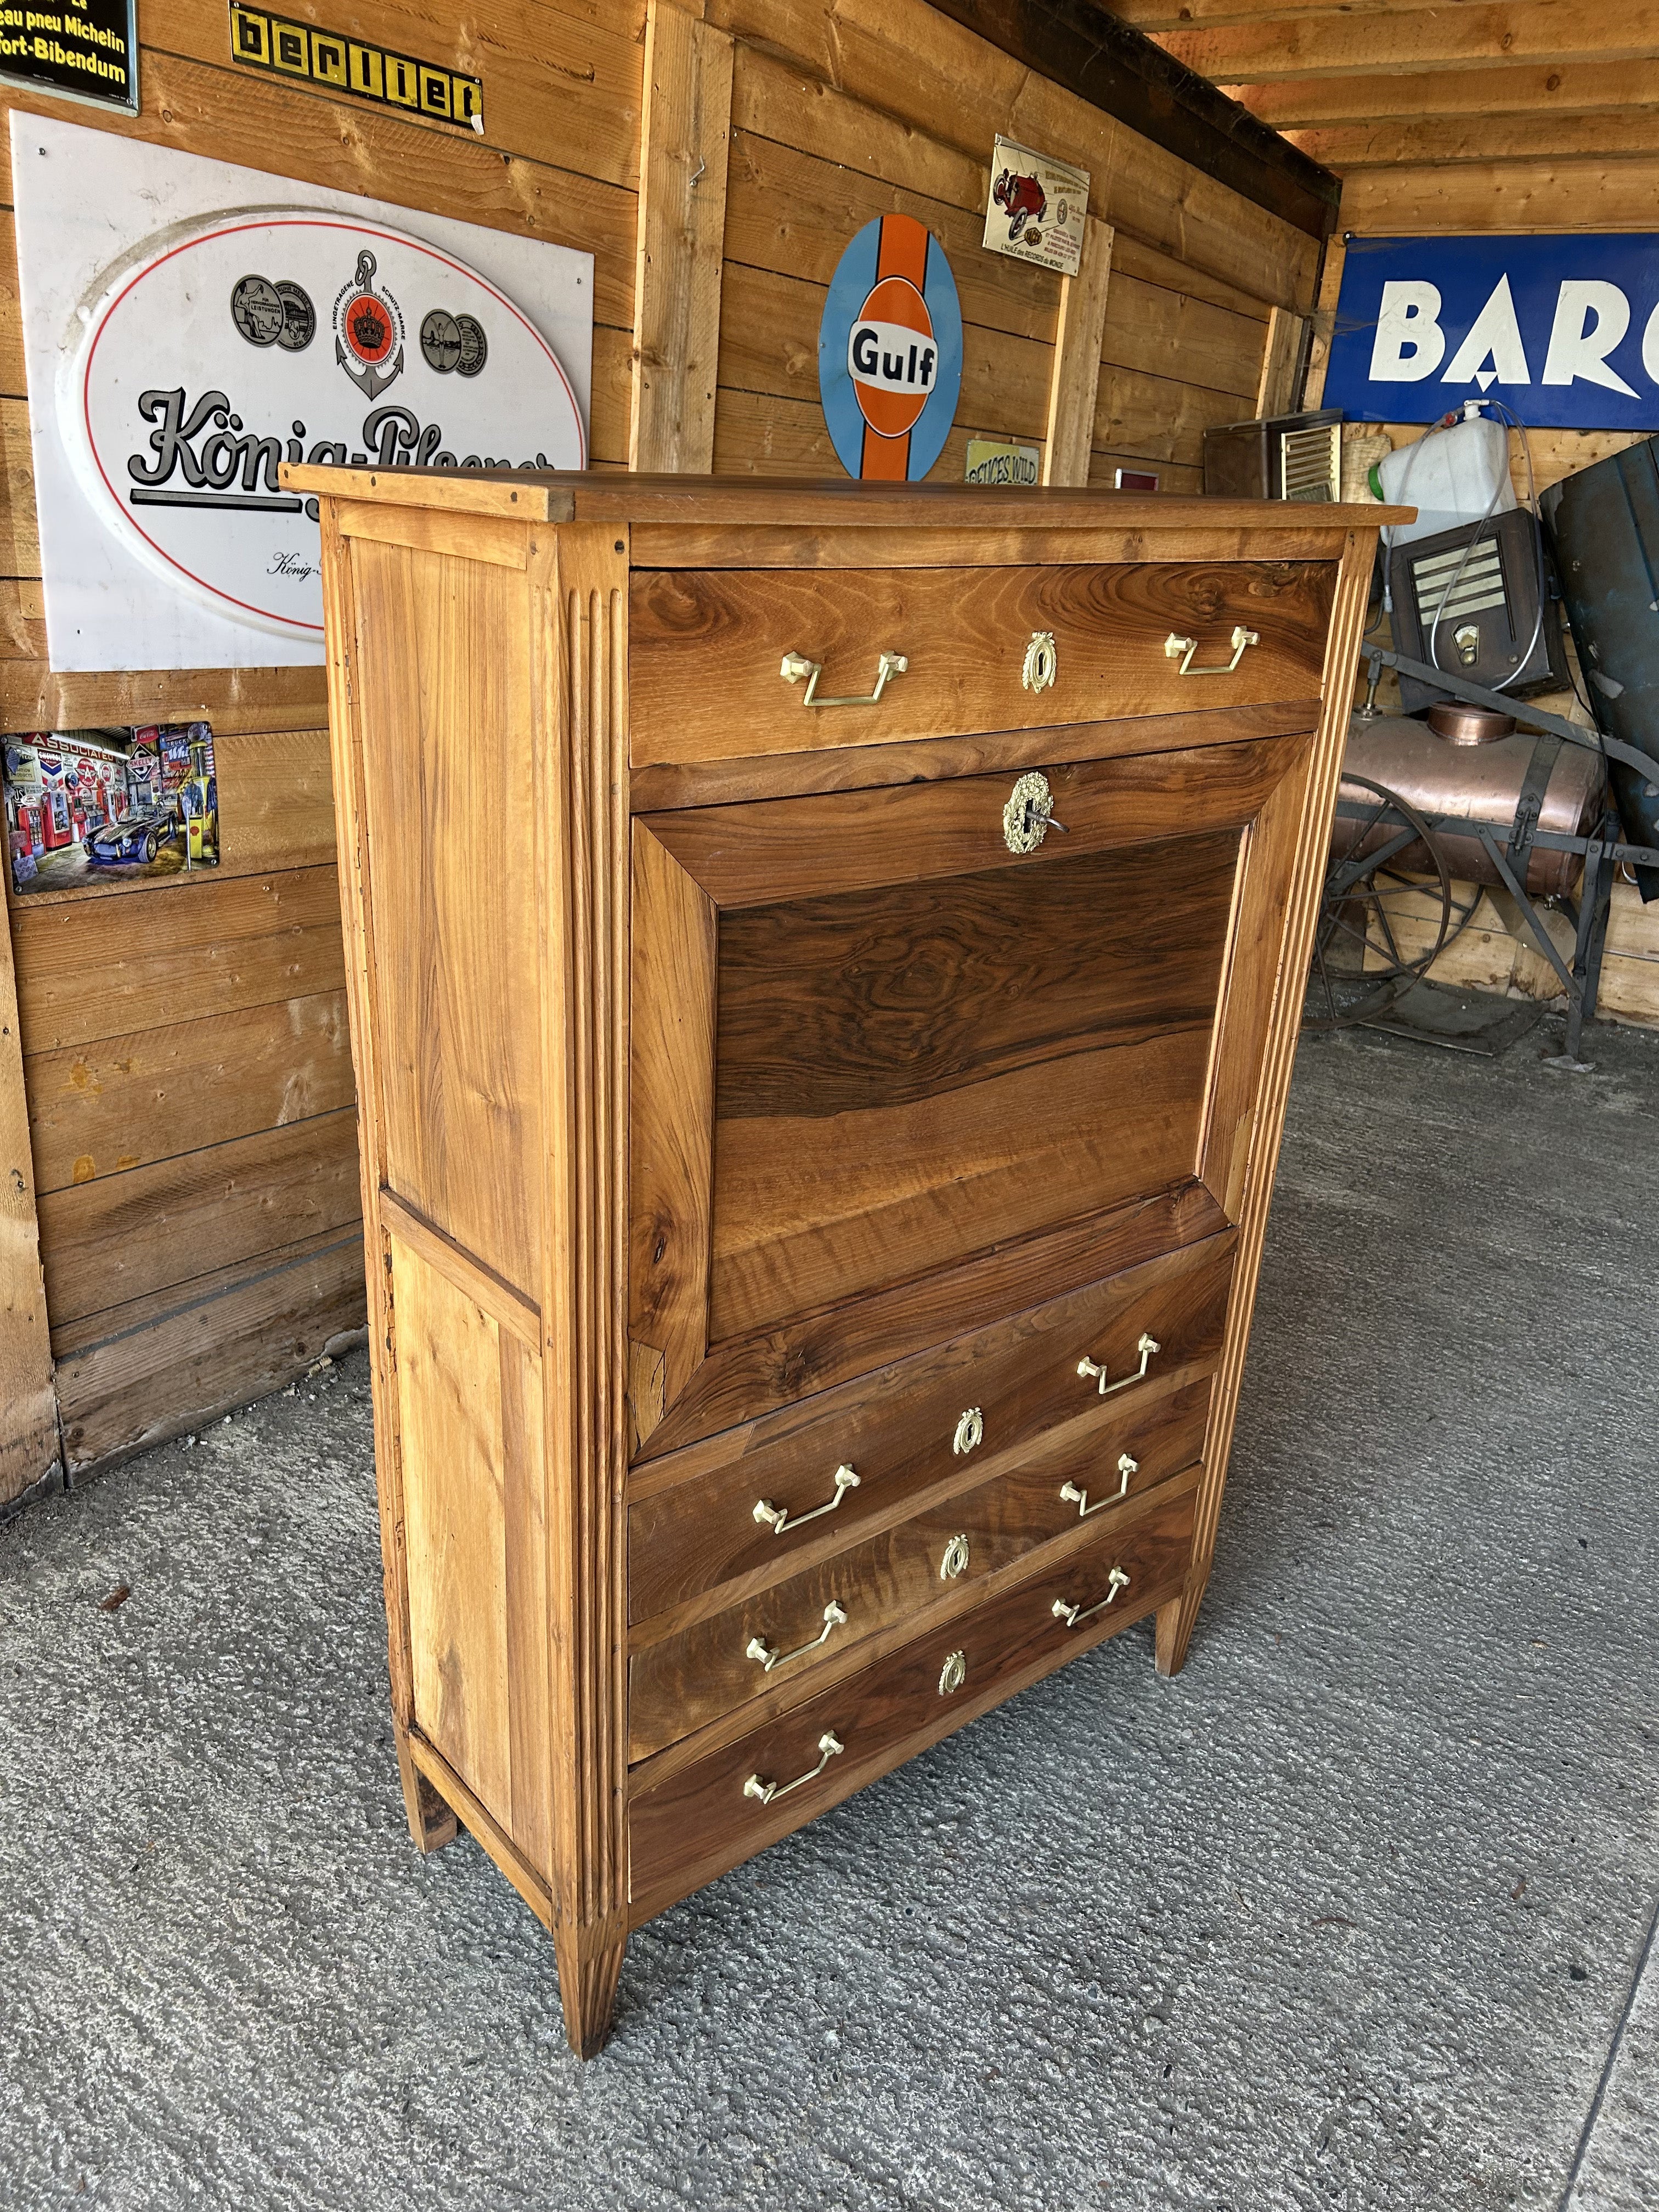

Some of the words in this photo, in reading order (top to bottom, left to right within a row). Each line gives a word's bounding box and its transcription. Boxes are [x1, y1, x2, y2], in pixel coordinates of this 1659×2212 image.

[26, 11, 61, 33] pneu
[65, 14, 125, 54] Michelin
[251, 304, 280, 314] LEISTUNGEN
[332, 280, 354, 329] EINGETRAGENE
[382, 286, 405, 340] SCHUTZ-MARKE
[853, 328, 934, 386] Gulf
[1369, 273, 1659, 399] BAR
[1012, 456, 1036, 484] WILD
[267, 552, 321, 582] König-
[129, 758, 152, 767] SKELLY
